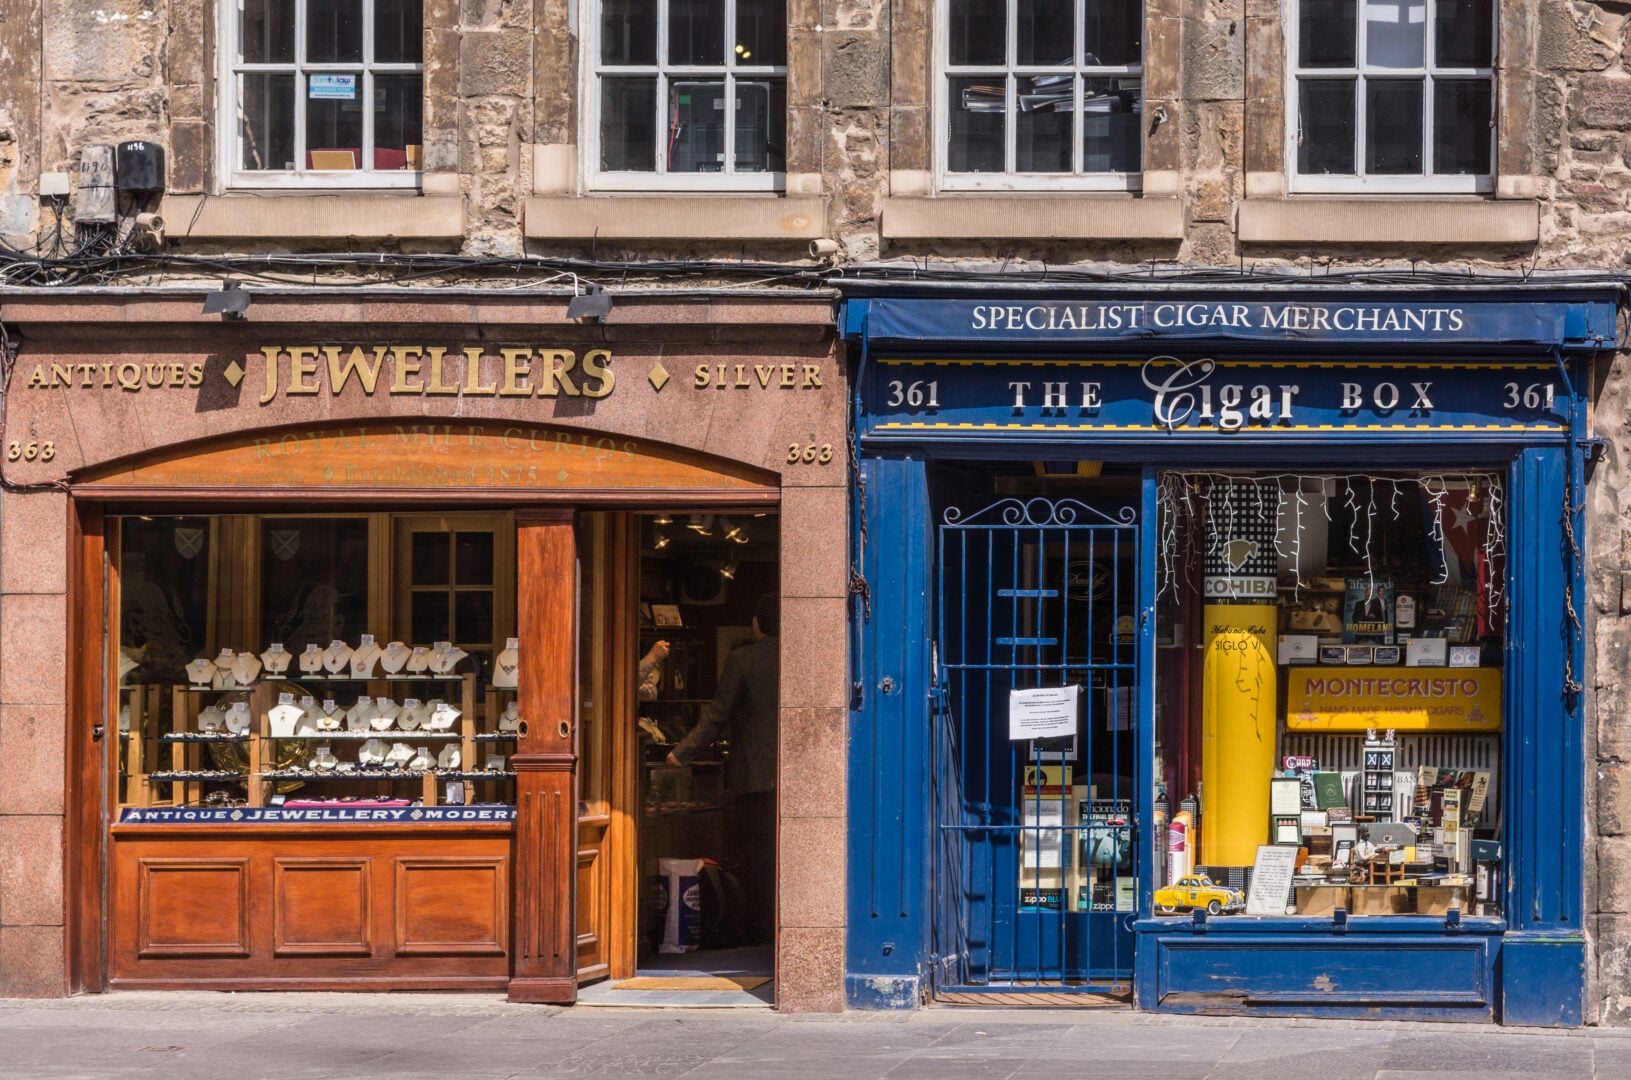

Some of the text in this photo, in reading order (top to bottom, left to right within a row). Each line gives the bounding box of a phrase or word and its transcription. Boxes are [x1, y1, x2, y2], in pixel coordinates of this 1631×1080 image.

[972, 304, 1463, 332] SPECIALIST CIGAR MERCHANTS
[28, 363, 203, 391] ANTIQUES
[259, 345, 616, 404] JEWELLERS
[694, 363, 823, 388] SILVER
[887, 380, 941, 407] 361
[1008, 355, 1434, 431] THE Cigar BOX
[1503, 382, 1556, 410] 361
[8, 441, 55, 461] 363
[254, 424, 637, 463] ROYAL MILE CURIOS
[787, 443, 833, 464] 363
[1205, 580, 1276, 594] COHIBA
[1350, 576, 1394, 589] aficinado
[1346, 623, 1393, 632] HOMELAND
[1215, 640, 1261, 651] SIGLO VI
[1305, 677, 1479, 698] MONTECRISTO
[1319, 706, 1465, 715] HAND MADE HAVANA CIGARS
[128, 811, 227, 820] ANTIQUE
[246, 810, 406, 820] JEWELLERY
[1082, 802, 1129, 813] aiciondo
